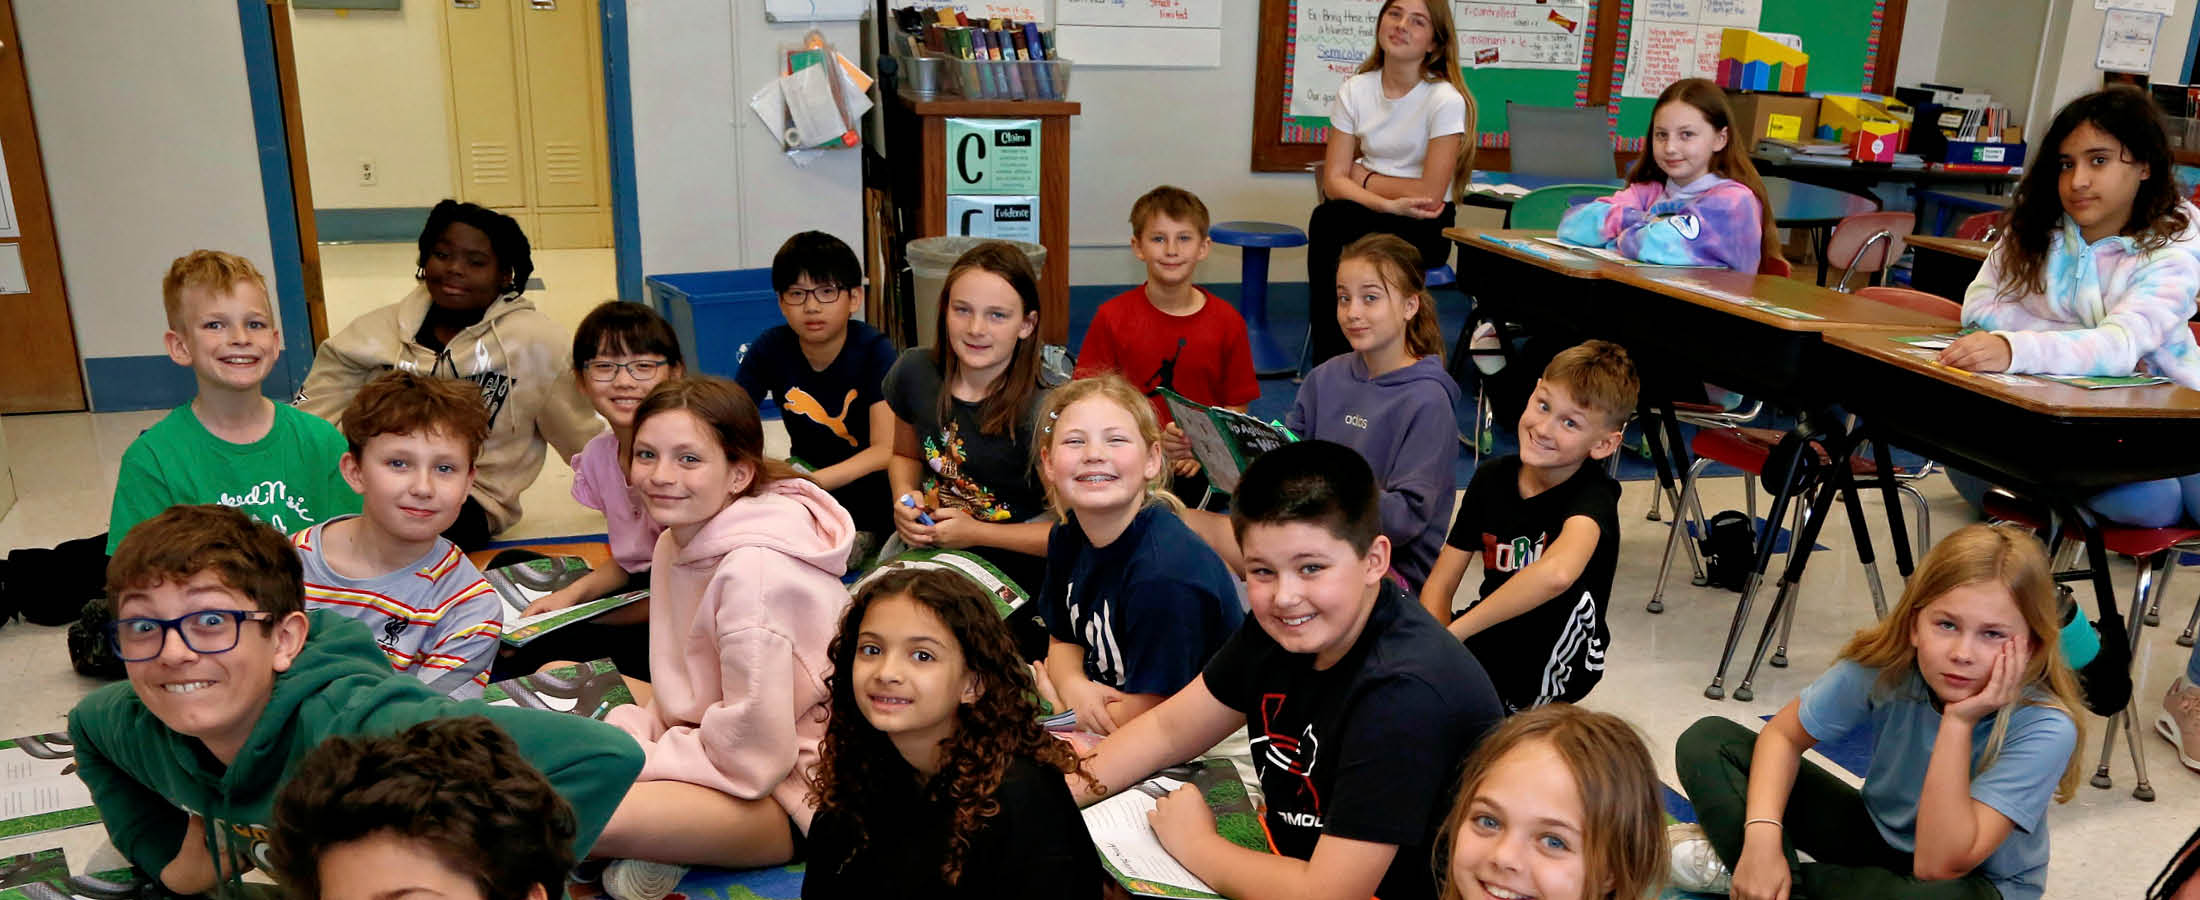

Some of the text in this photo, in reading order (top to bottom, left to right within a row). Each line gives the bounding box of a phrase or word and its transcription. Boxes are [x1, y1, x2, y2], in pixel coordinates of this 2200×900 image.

[1001, 132, 1026, 144] Claim
[957, 132, 986, 184] C
[996, 208, 1029, 219] Evidence
